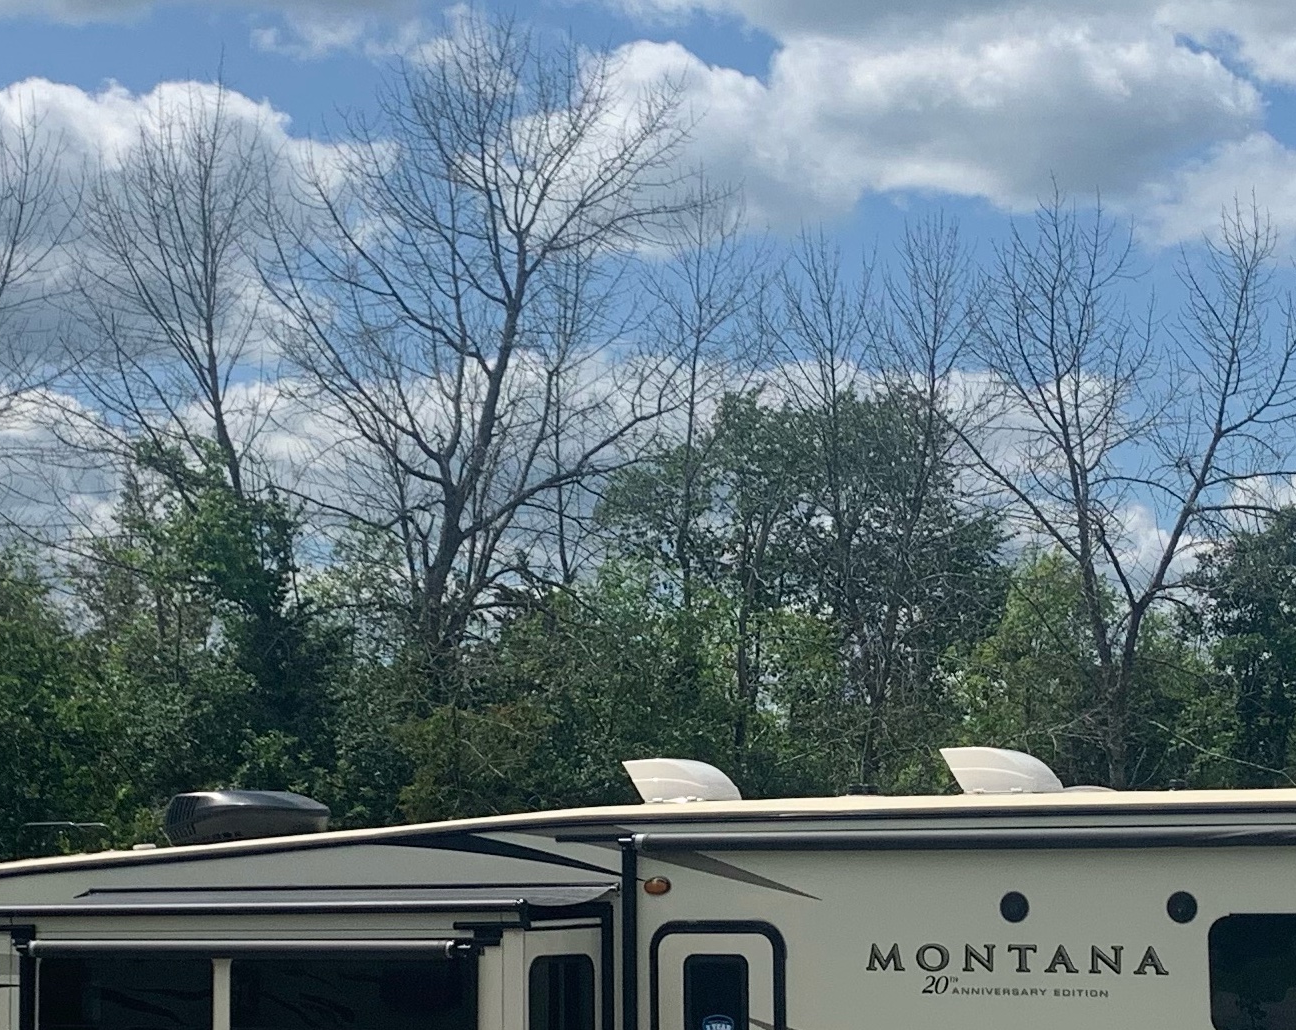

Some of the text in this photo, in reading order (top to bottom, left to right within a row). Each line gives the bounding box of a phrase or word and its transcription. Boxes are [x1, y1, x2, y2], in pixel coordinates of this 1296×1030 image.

[866, 942, 1170, 976] MONTANA
[952, 986, 1047, 997] ANNIVERSARY
[1054, 988, 1109, 998] EDITION
